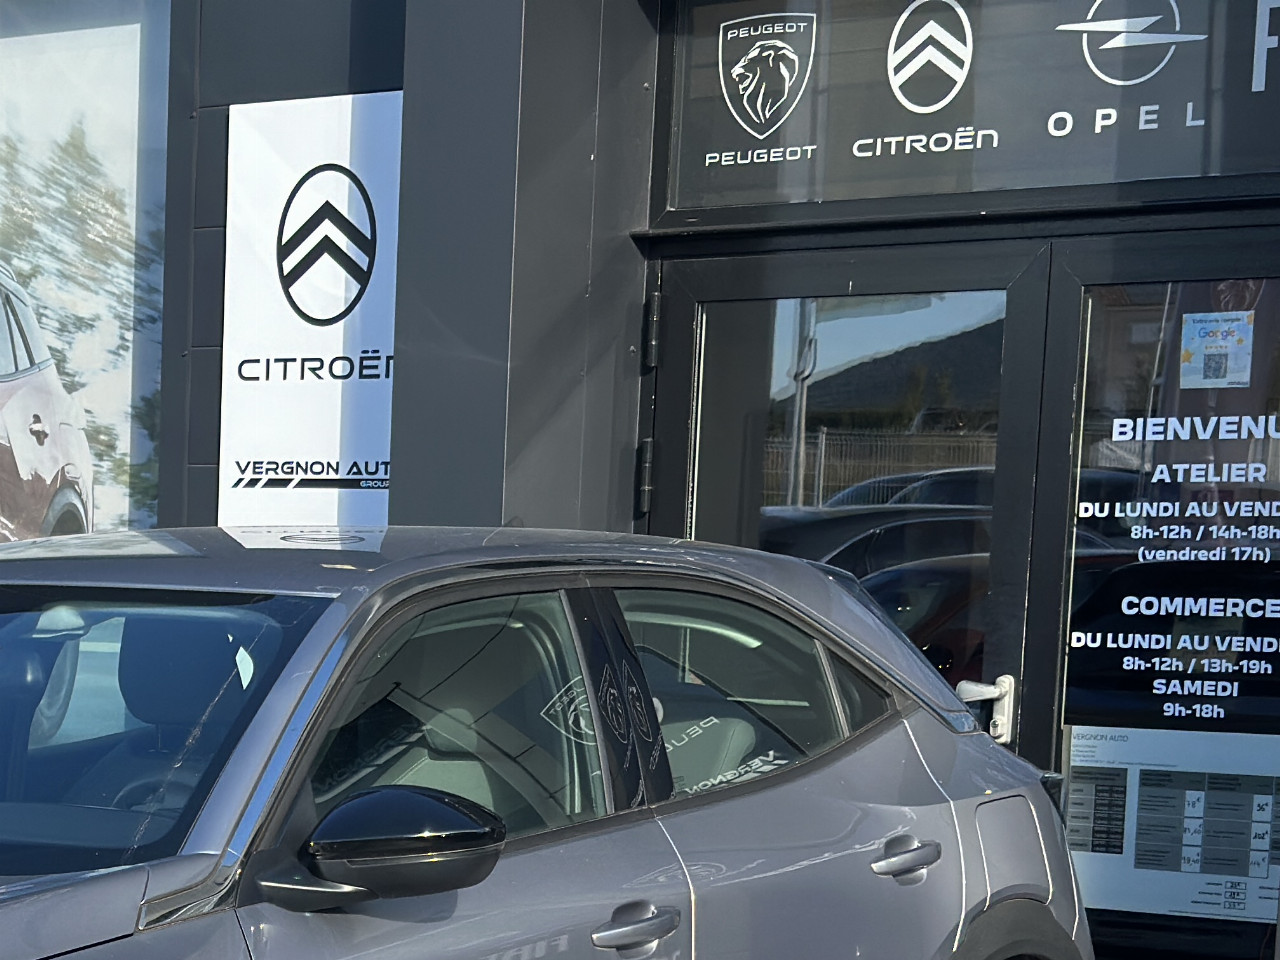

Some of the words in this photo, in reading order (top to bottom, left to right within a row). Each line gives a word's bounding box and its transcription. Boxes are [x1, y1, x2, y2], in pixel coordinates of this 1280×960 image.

[727, 22, 809, 41] PEUGEOT
[1047, 101, 1206, 138] OPEL
[705, 145, 817, 167] PEUGEOT
[235, 461, 340, 475] VERGNON
[1151, 463, 1267, 483] ATELIER
[1078, 502, 1110, 518] DU
[1114, 502, 1179, 518] LUNDI
[1184, 501, 1218, 517] AU
[1130, 525, 1191, 540] 8h-12h
[1195, 526, 1205, 541] /
[1137, 546, 1226, 562] (vendredi
[1231, 546, 1271, 564] 17h)
[1121, 596, 1280, 618] COMMERCE
[1070, 631, 1102, 648] DU
[1106, 633, 1172, 650] LUNDI
[1177, 634, 1210, 651] AU
[1215, 635, 1280, 653] VEND
[1122, 656, 1183, 671] 8h-12h
[1187, 658, 1196, 674] /
[1200, 658, 1272, 674] 13h-19h
[1152, 678, 1239, 697] SAMEDI
[1163, 702, 1225, 719] 9h-18h
